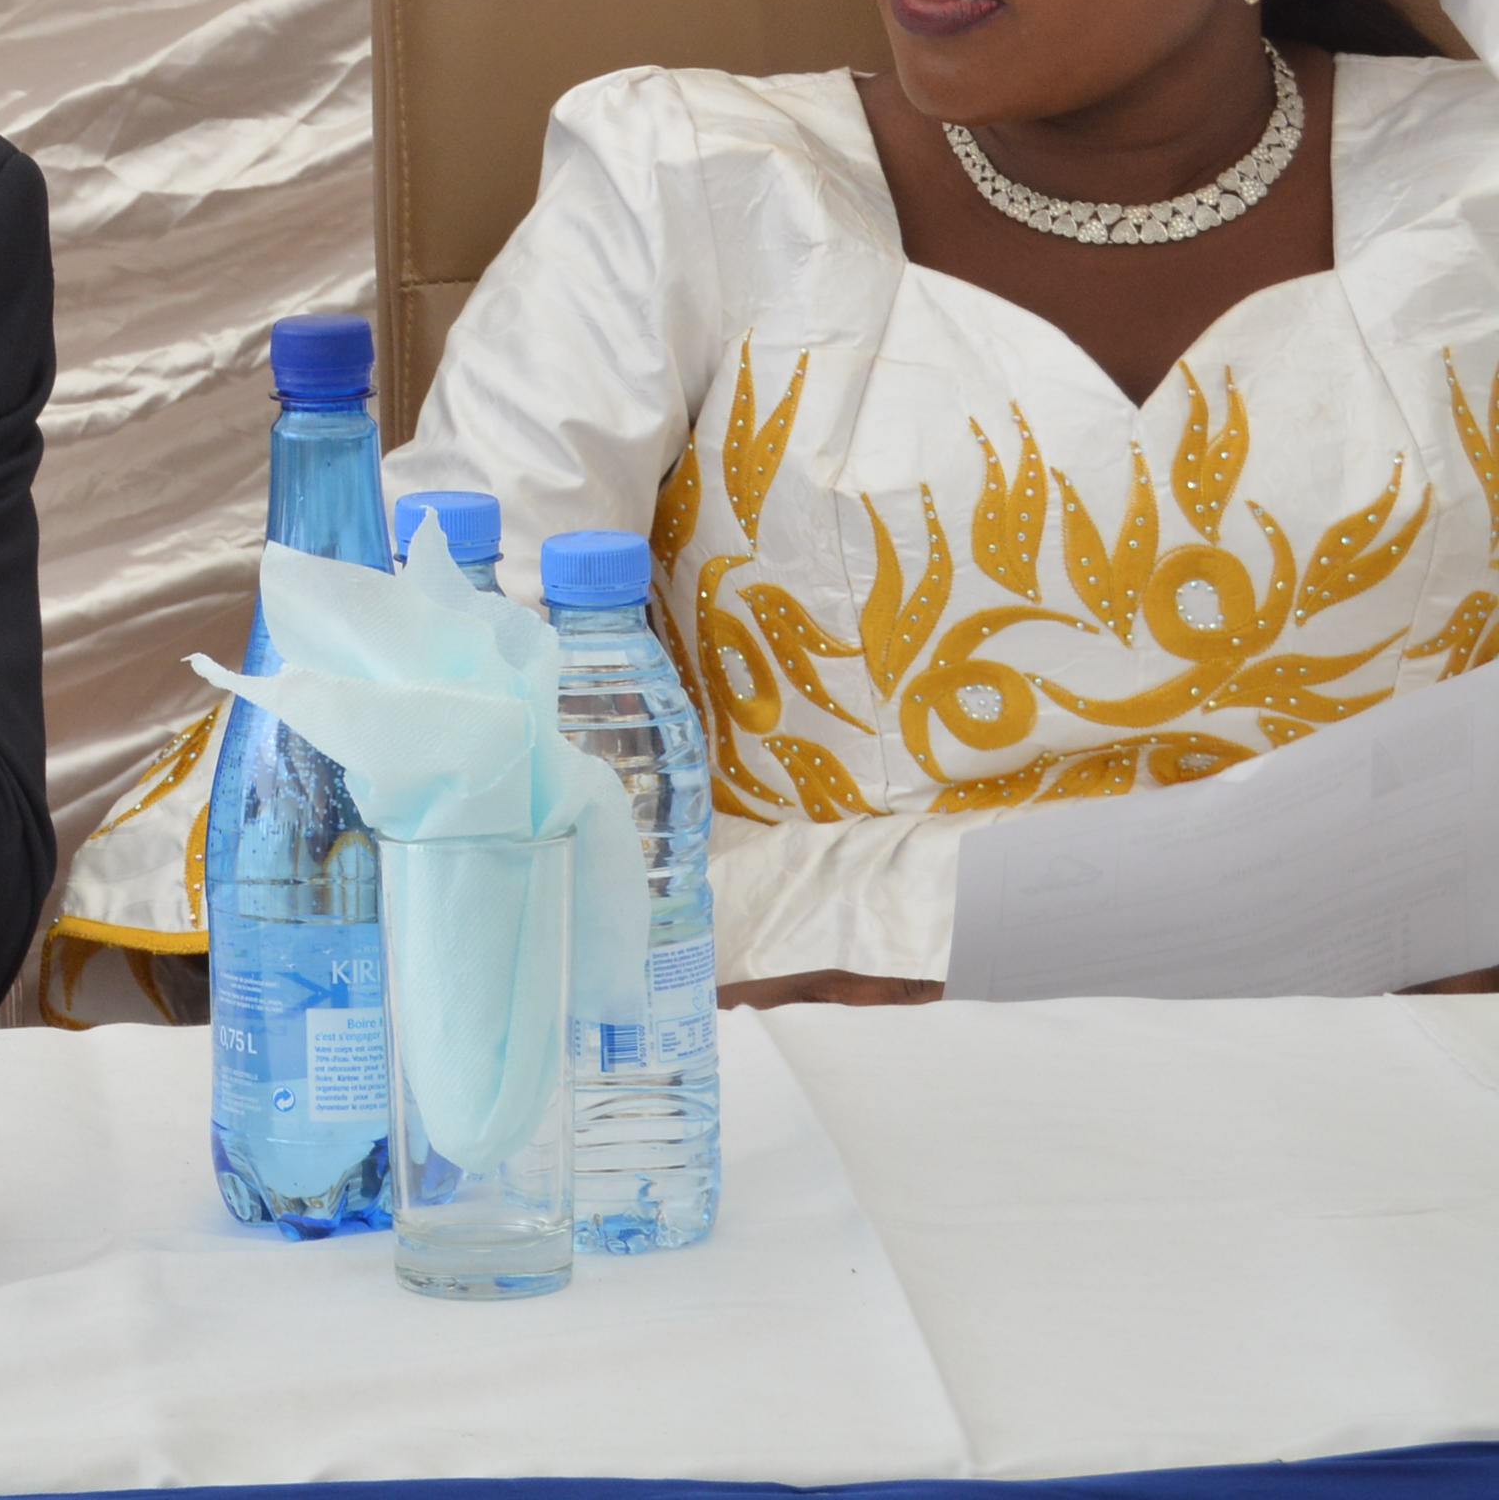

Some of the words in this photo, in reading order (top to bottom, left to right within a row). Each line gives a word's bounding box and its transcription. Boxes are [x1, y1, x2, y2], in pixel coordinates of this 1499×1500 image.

[331, 959, 380, 985] KIR
[347, 1018, 377, 1029] Boire
[220, 1025, 245, 1052] 0,75
[247, 1032, 258, 1055] L
